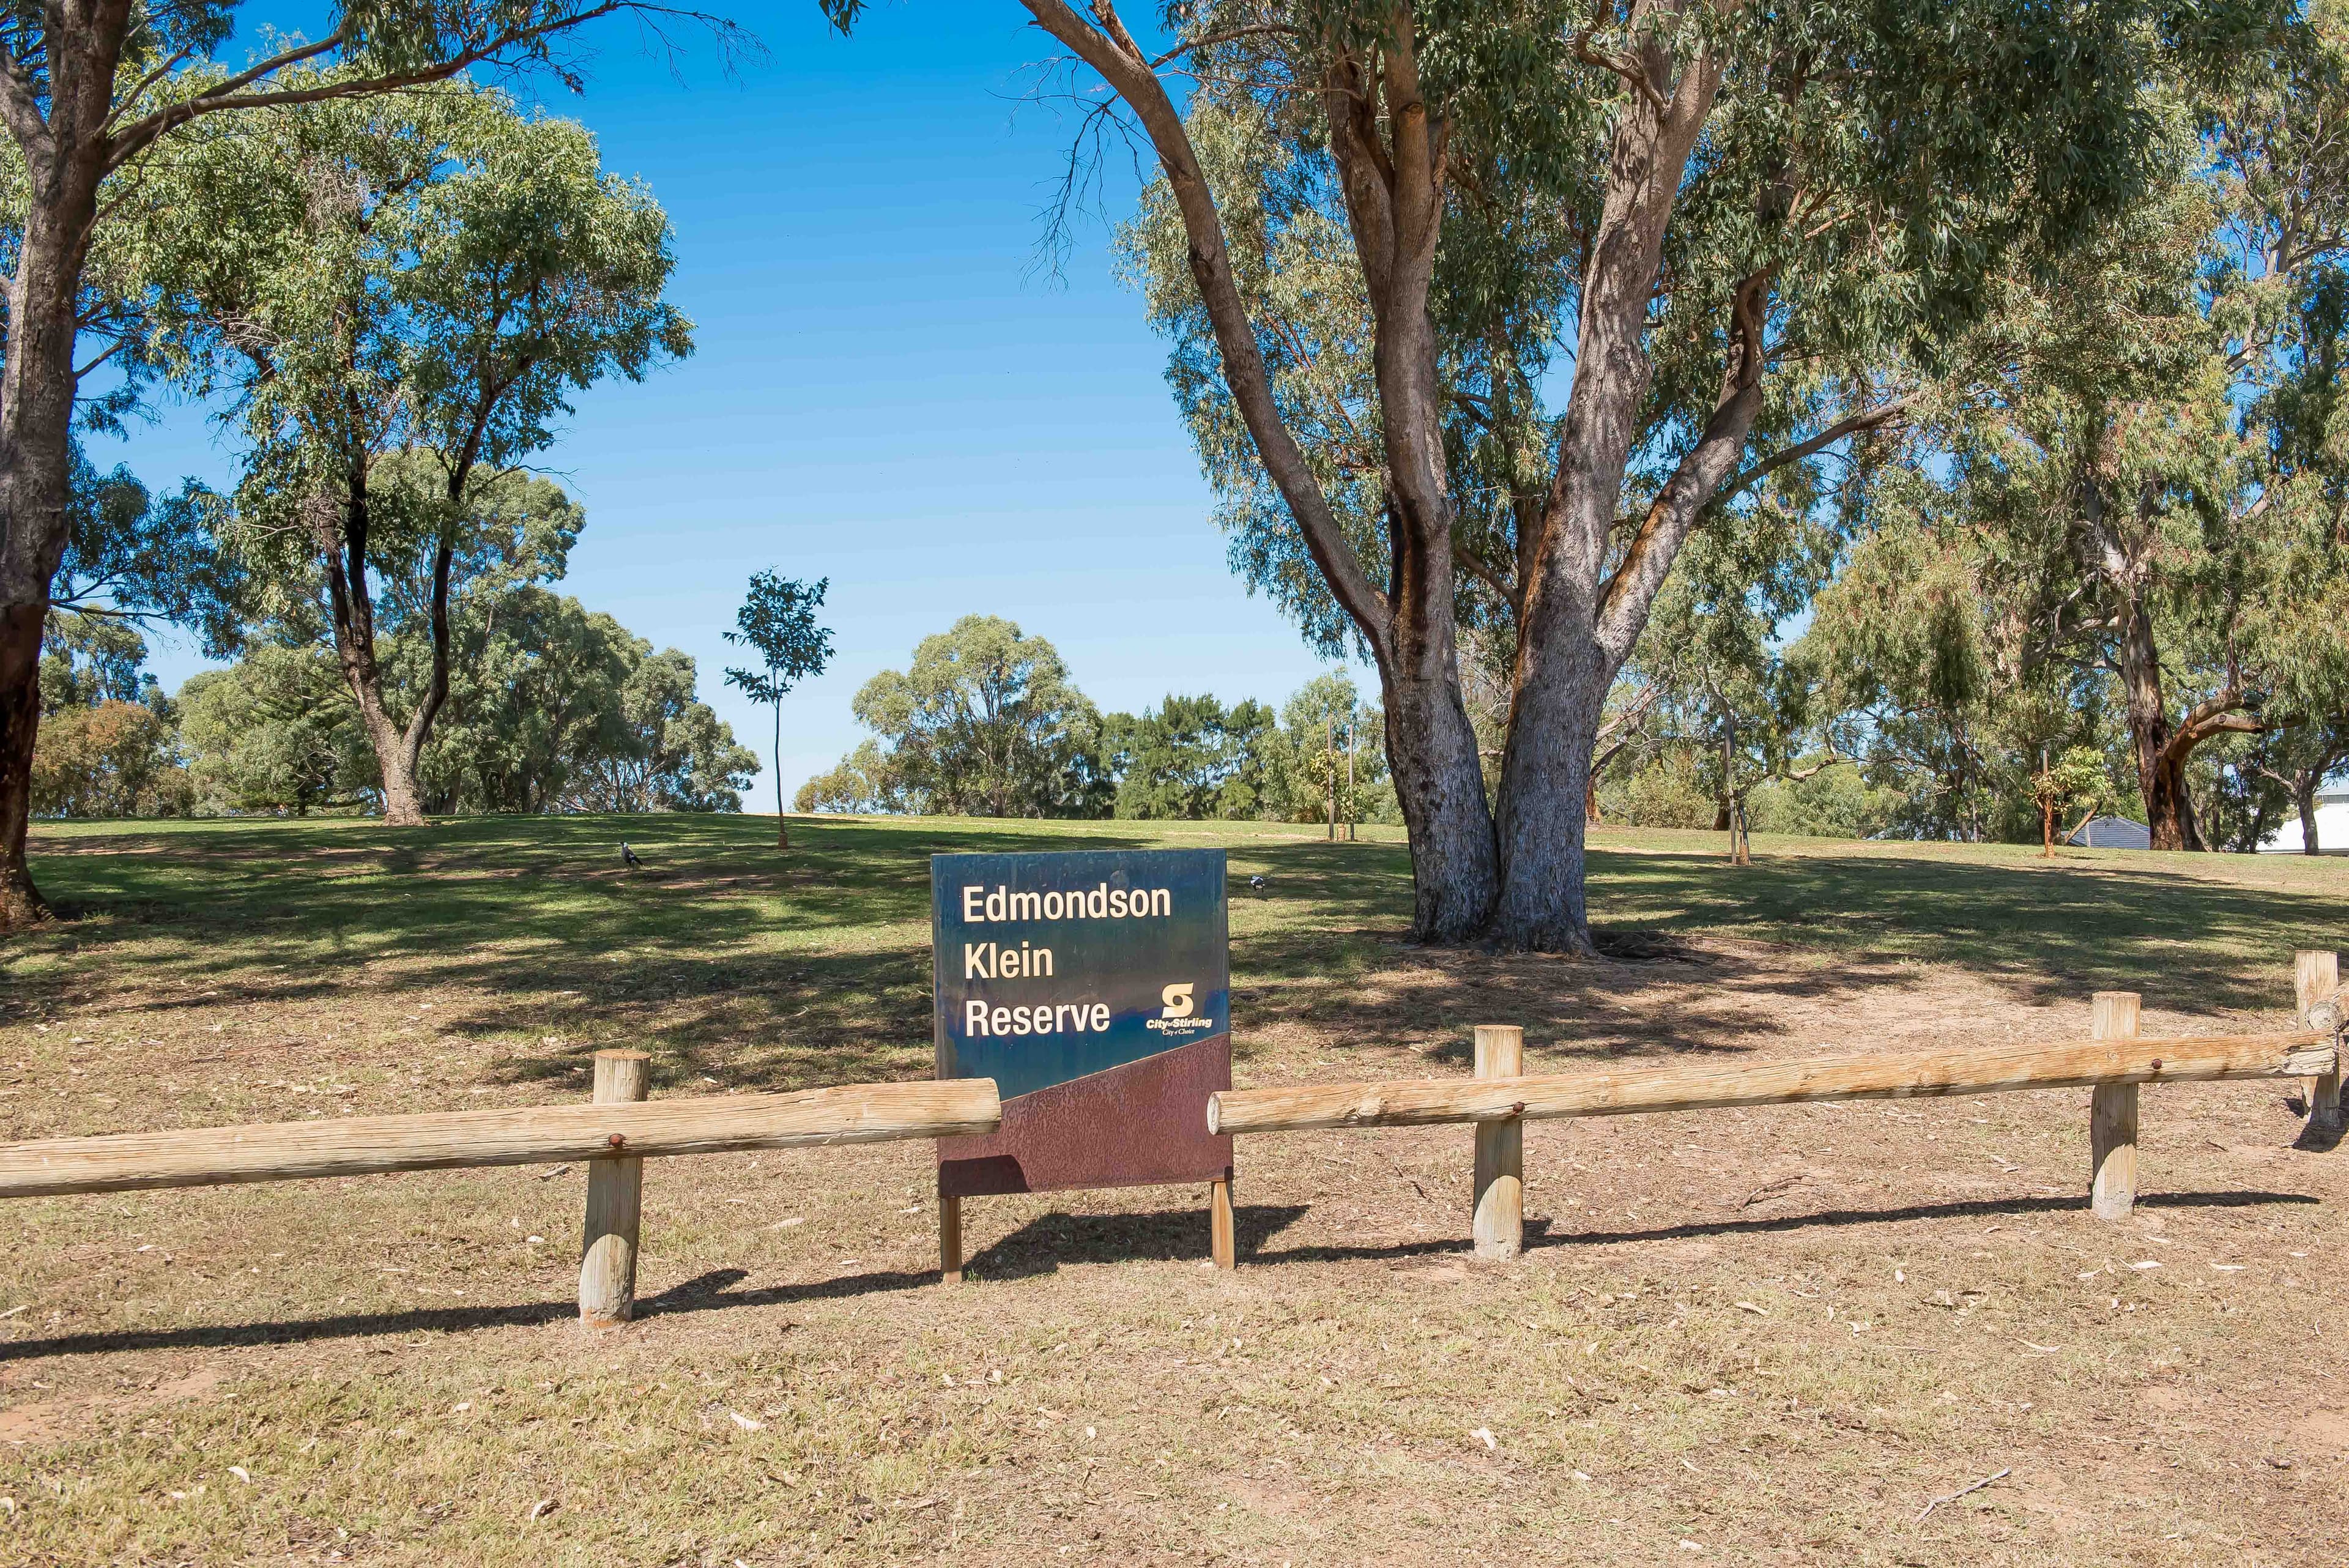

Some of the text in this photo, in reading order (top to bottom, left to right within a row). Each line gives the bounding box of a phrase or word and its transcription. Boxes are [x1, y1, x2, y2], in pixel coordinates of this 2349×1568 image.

[963, 882, 1171, 923] Edmondson
[965, 941, 1053, 979] Klein
[966, 1000, 1110, 1037] Reserve
[1146, 1019, 1168, 1030] City
[1173, 1017, 1212, 1028] Stirling
